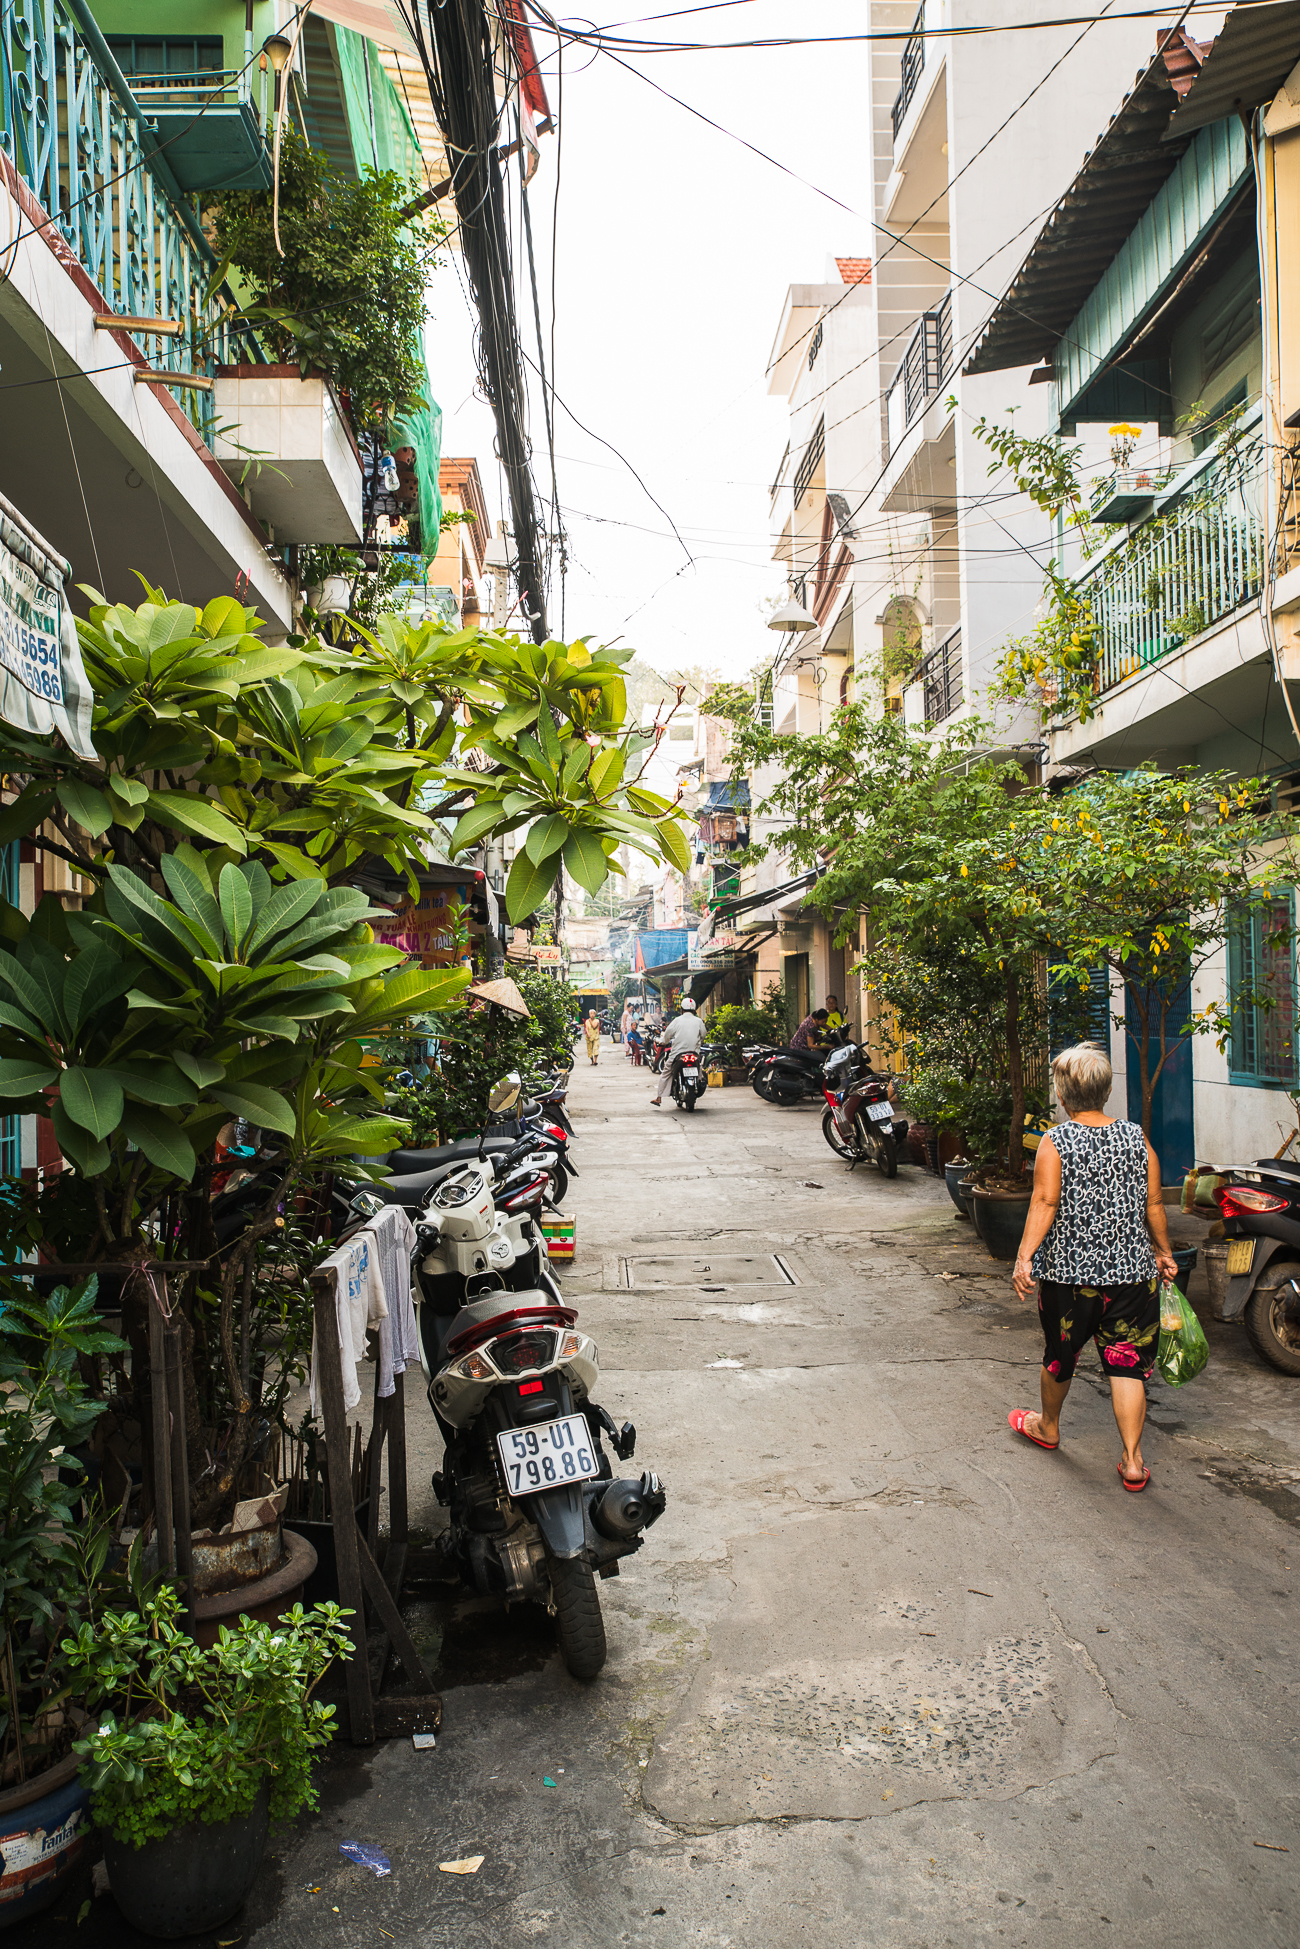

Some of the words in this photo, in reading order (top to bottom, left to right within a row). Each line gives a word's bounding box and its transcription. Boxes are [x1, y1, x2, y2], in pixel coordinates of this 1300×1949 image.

[380, 932, 420, 952] MUA
[424, 932, 430, 952] 2
[512, 1422, 574, 1458] 59-U1
[509, 1448, 592, 1490] 798.86
